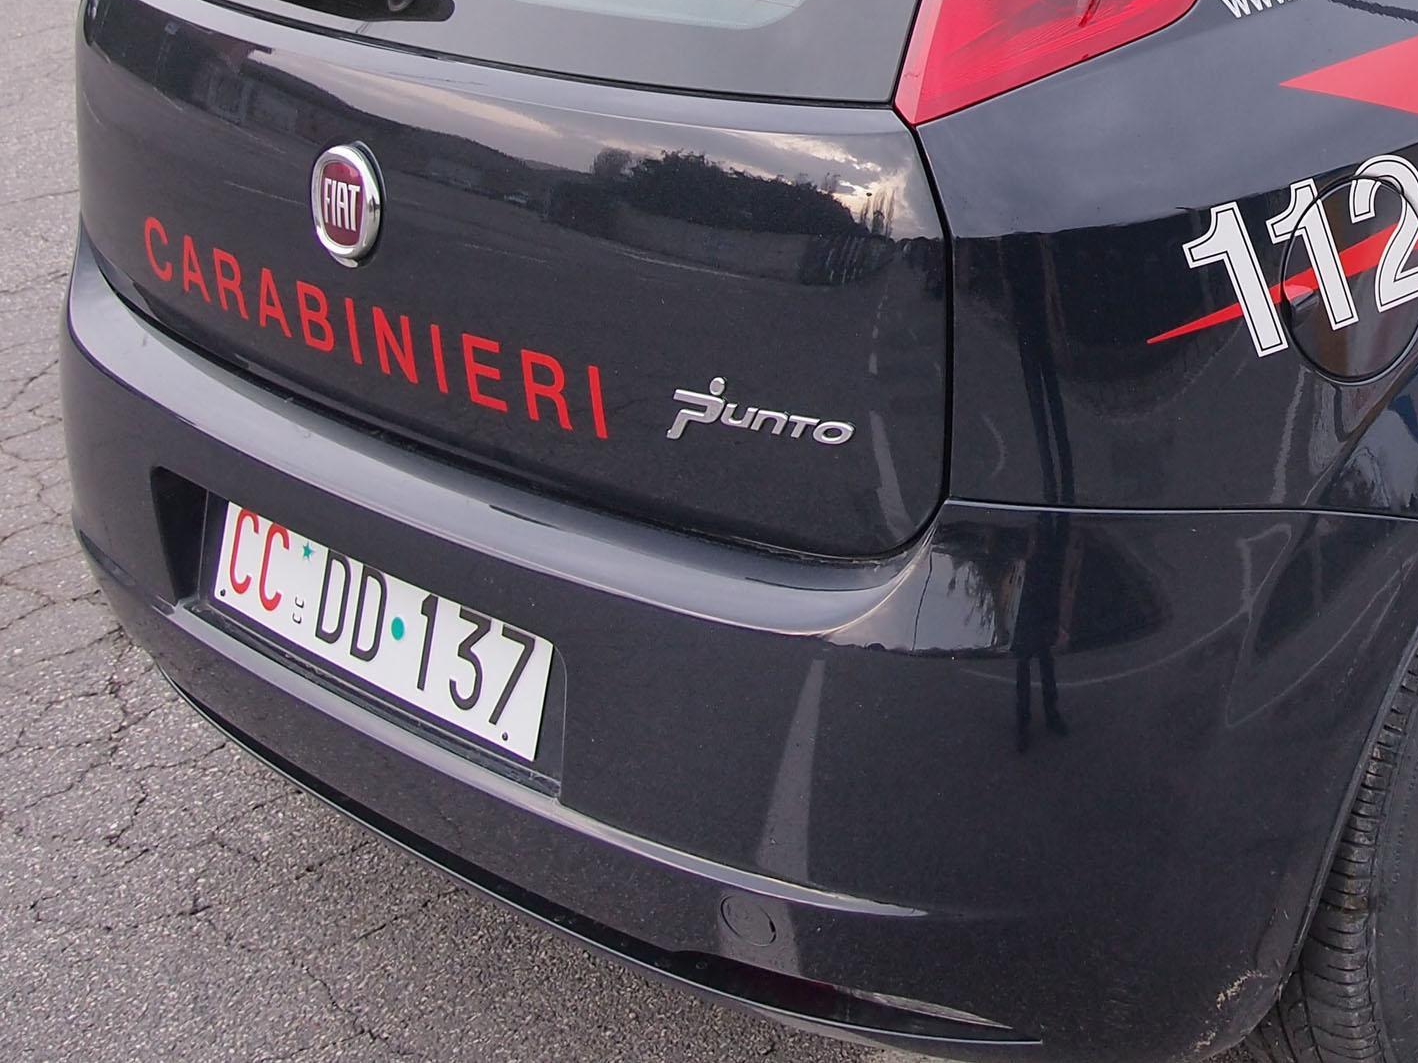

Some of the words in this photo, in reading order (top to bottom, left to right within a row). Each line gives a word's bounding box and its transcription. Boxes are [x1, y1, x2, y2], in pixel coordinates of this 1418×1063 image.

[323, 177, 361, 232] FIAT
[143, 215, 609, 440] CARABINIERI
[229, 508, 290, 612] CC
[315, 548, 388, 662] DD
[416, 593, 537, 726] 137
